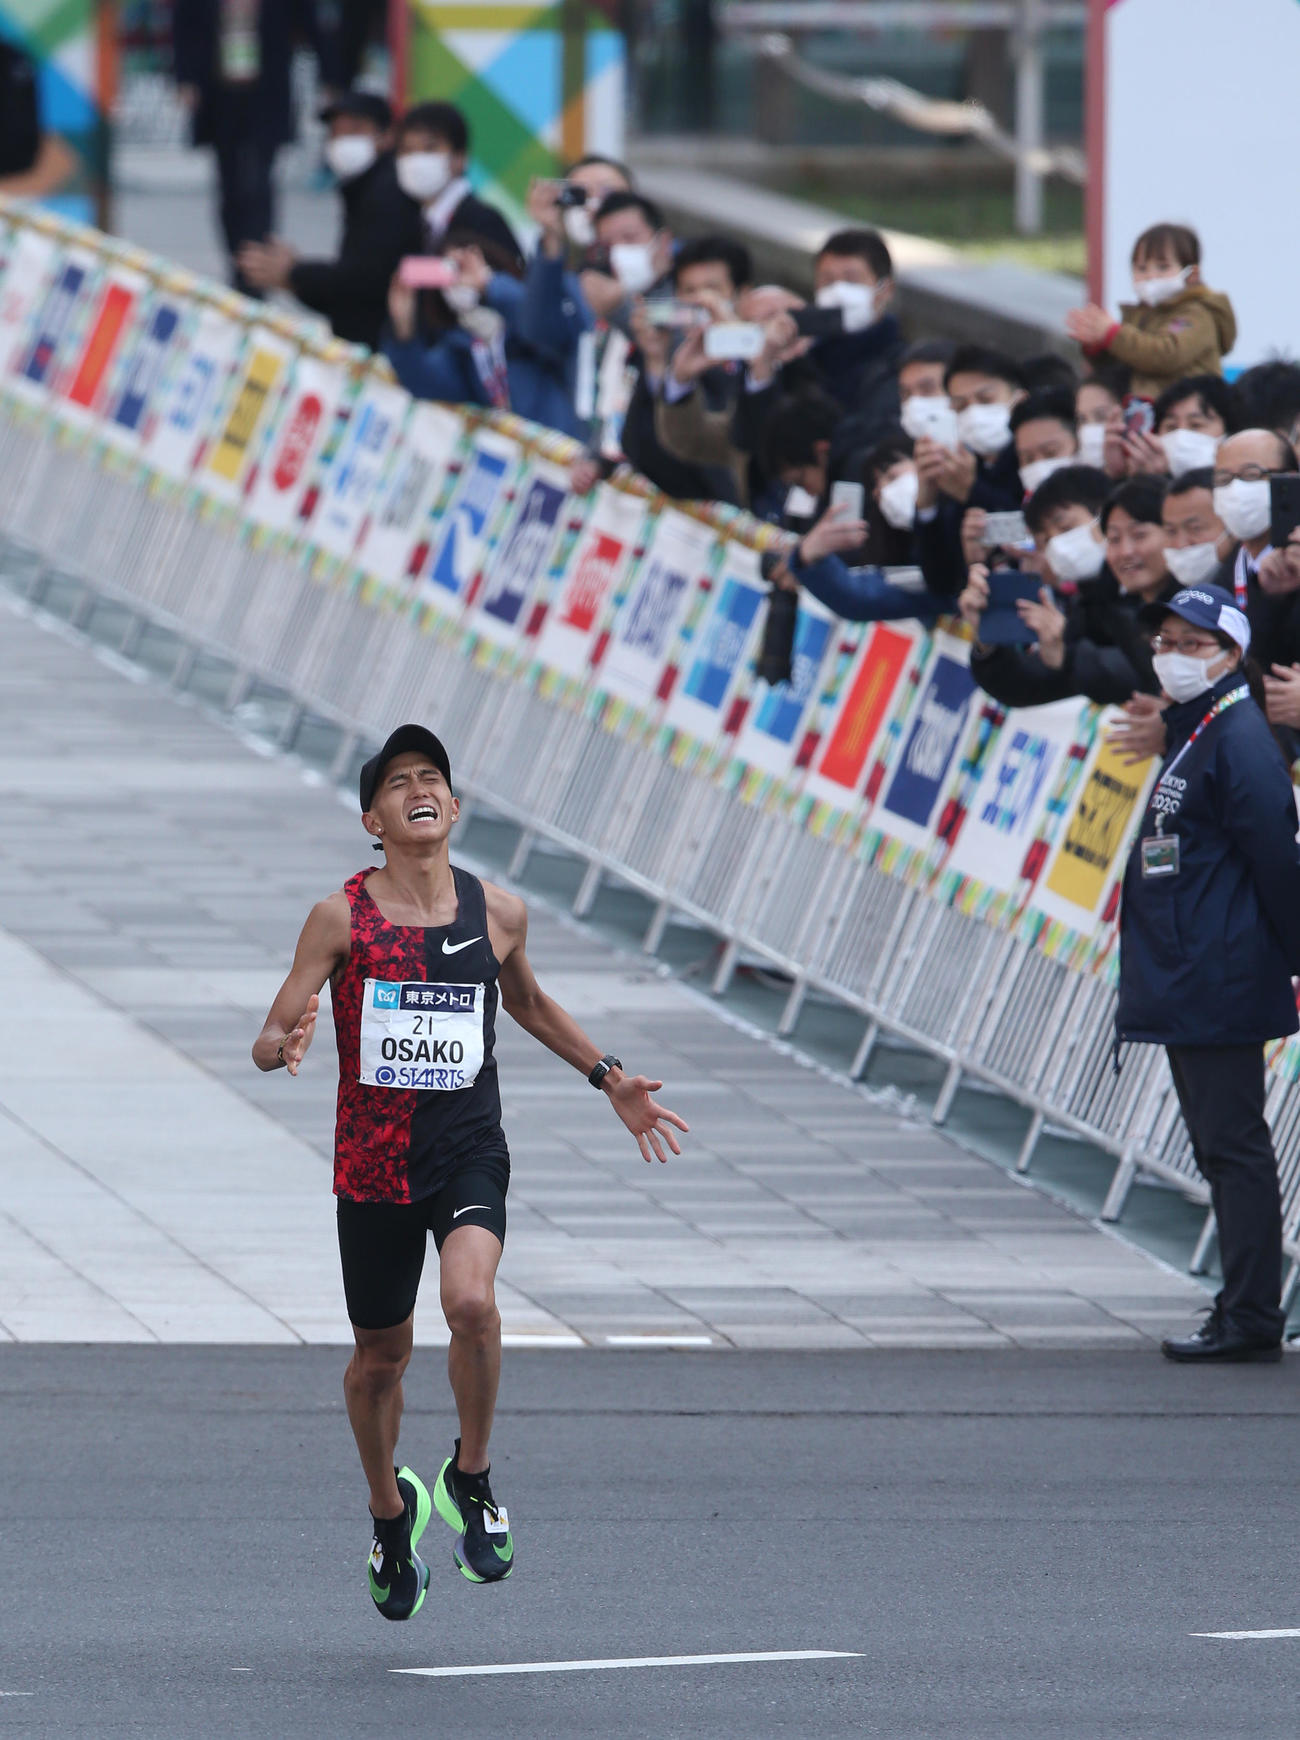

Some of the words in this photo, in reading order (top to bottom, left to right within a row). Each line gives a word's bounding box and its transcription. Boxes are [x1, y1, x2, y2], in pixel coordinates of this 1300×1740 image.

[405, 990, 471, 1006] 東京メトロ
[412, 1015, 433, 1035] 21
[381, 1037, 464, 1064] OSAKO
[398, 1067, 465, 1089] STARTS
